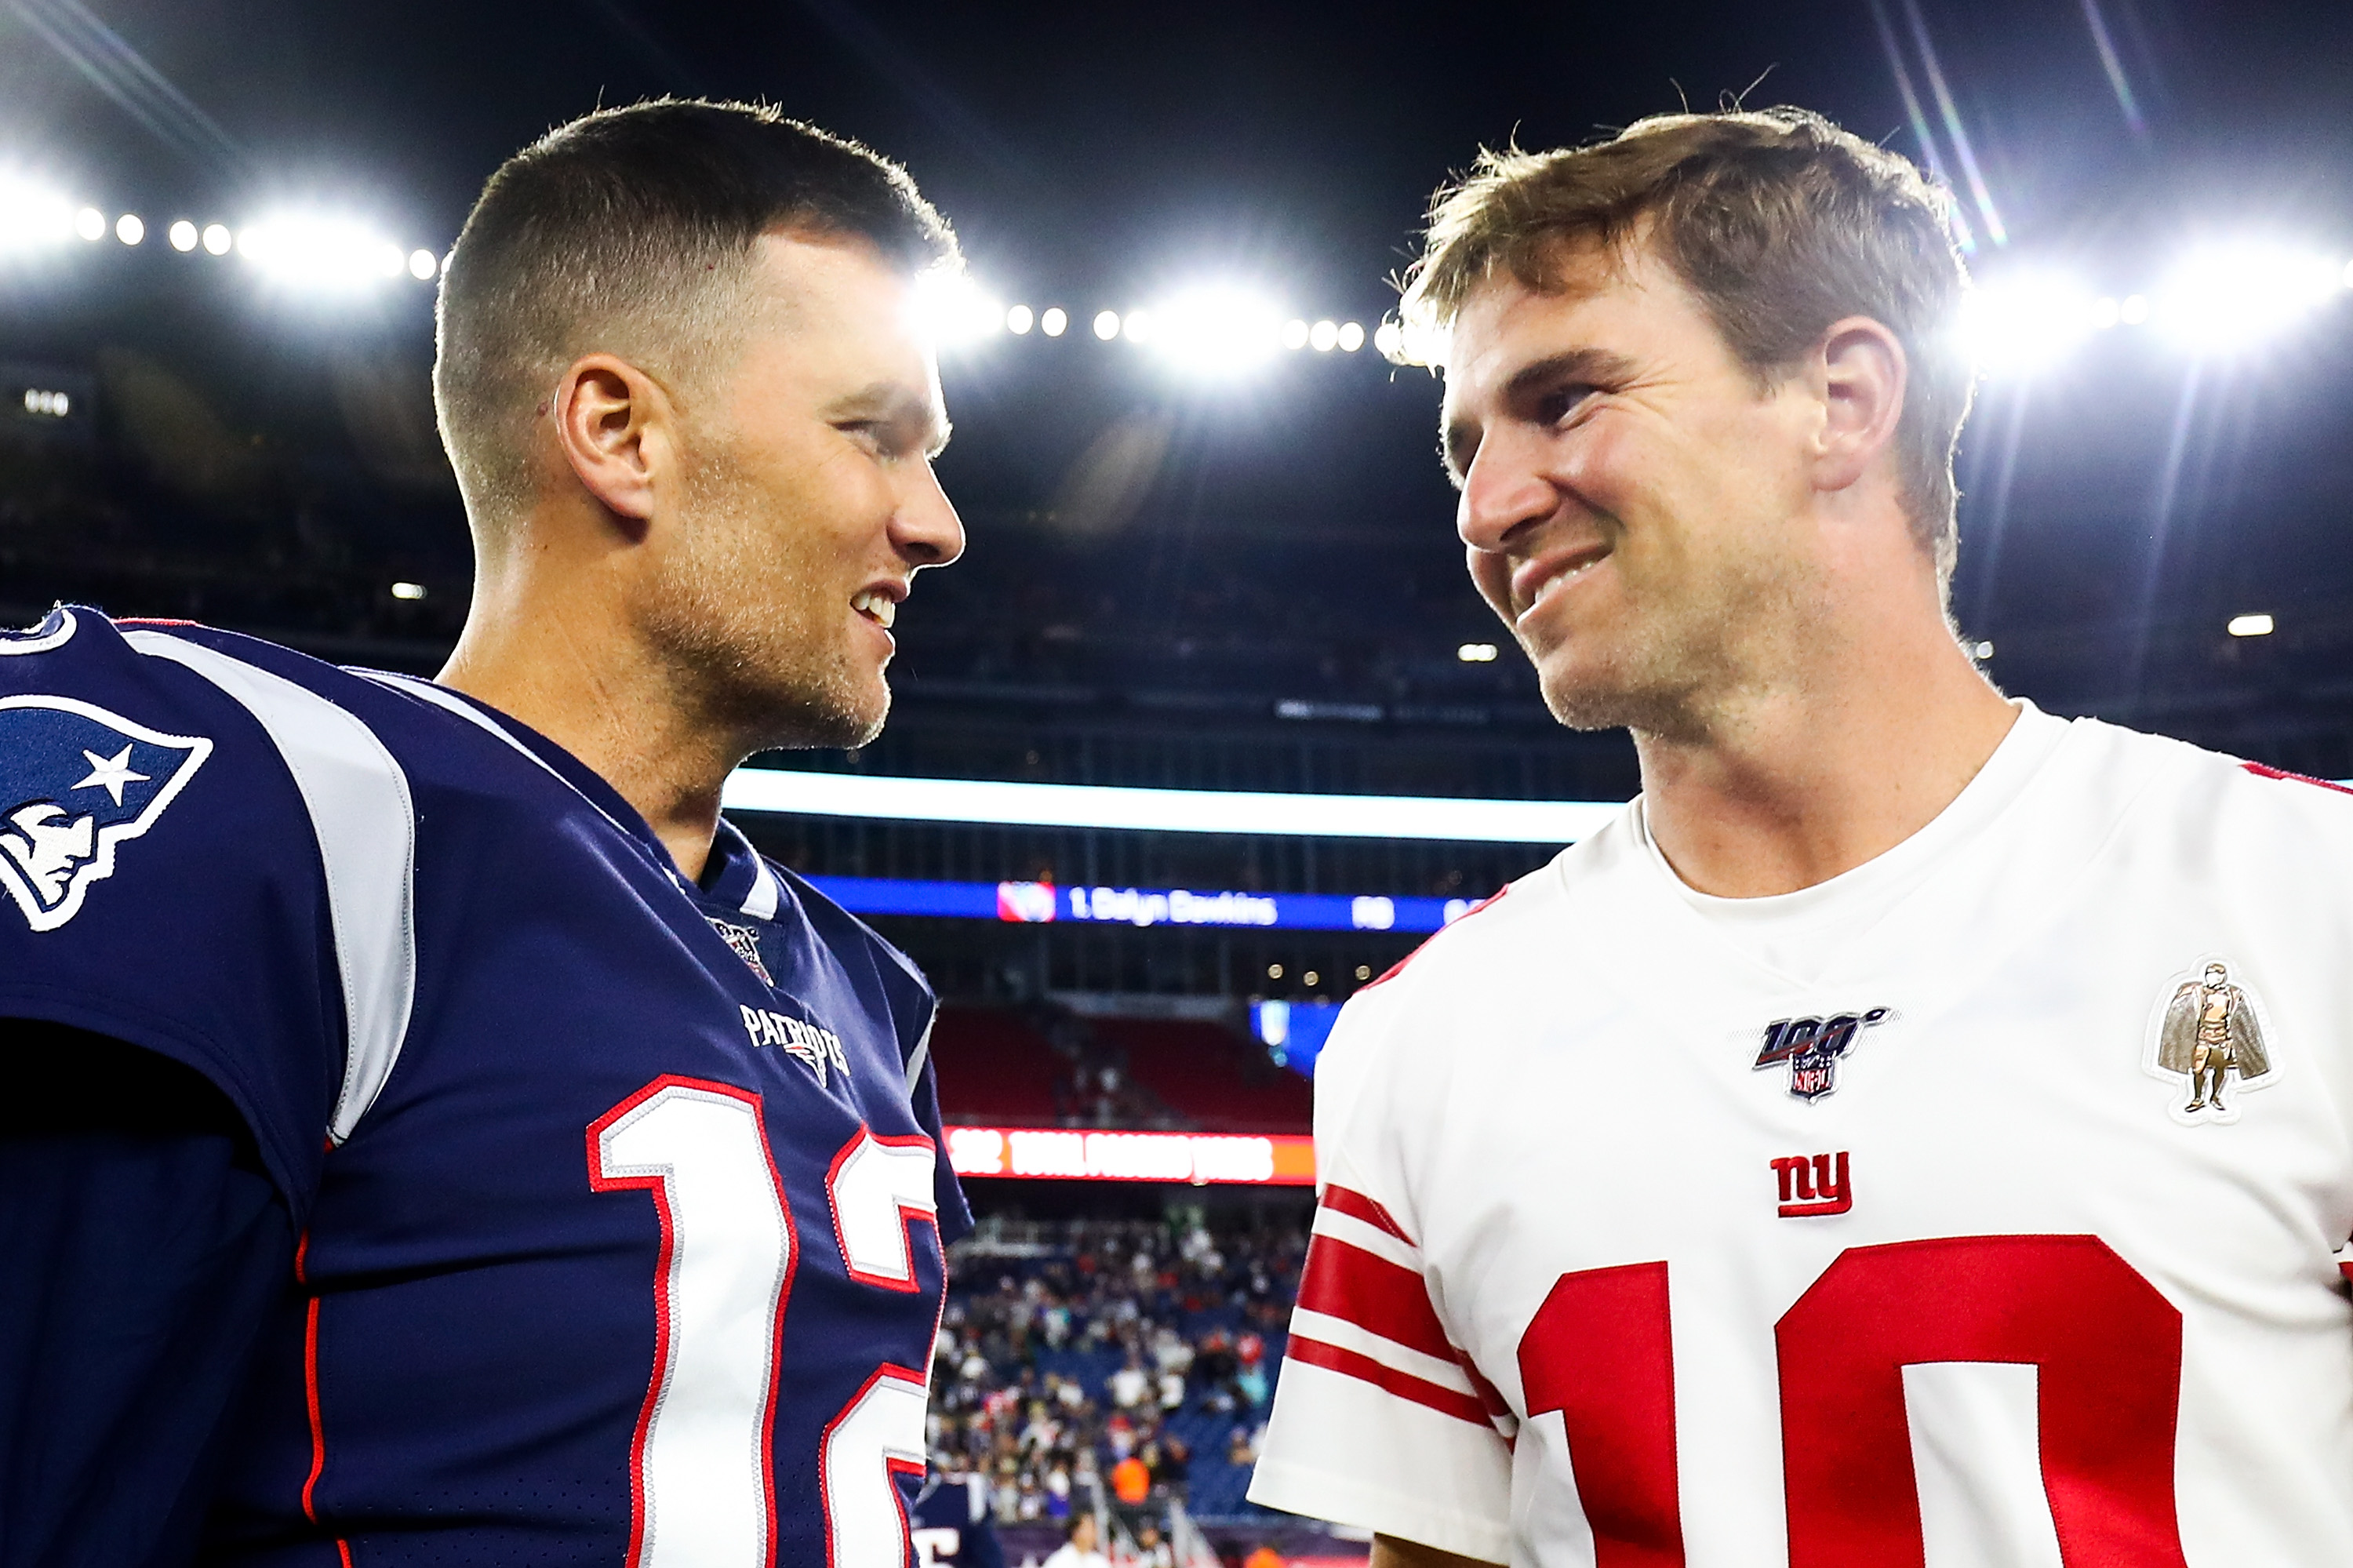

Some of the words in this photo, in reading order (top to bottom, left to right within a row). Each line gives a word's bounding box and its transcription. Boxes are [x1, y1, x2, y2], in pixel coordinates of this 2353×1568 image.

[740, 1004, 851, 1077] PATRIOTS
[586, 1073, 947, 1568] 12
[1517, 1234, 2188, 1568] 10
